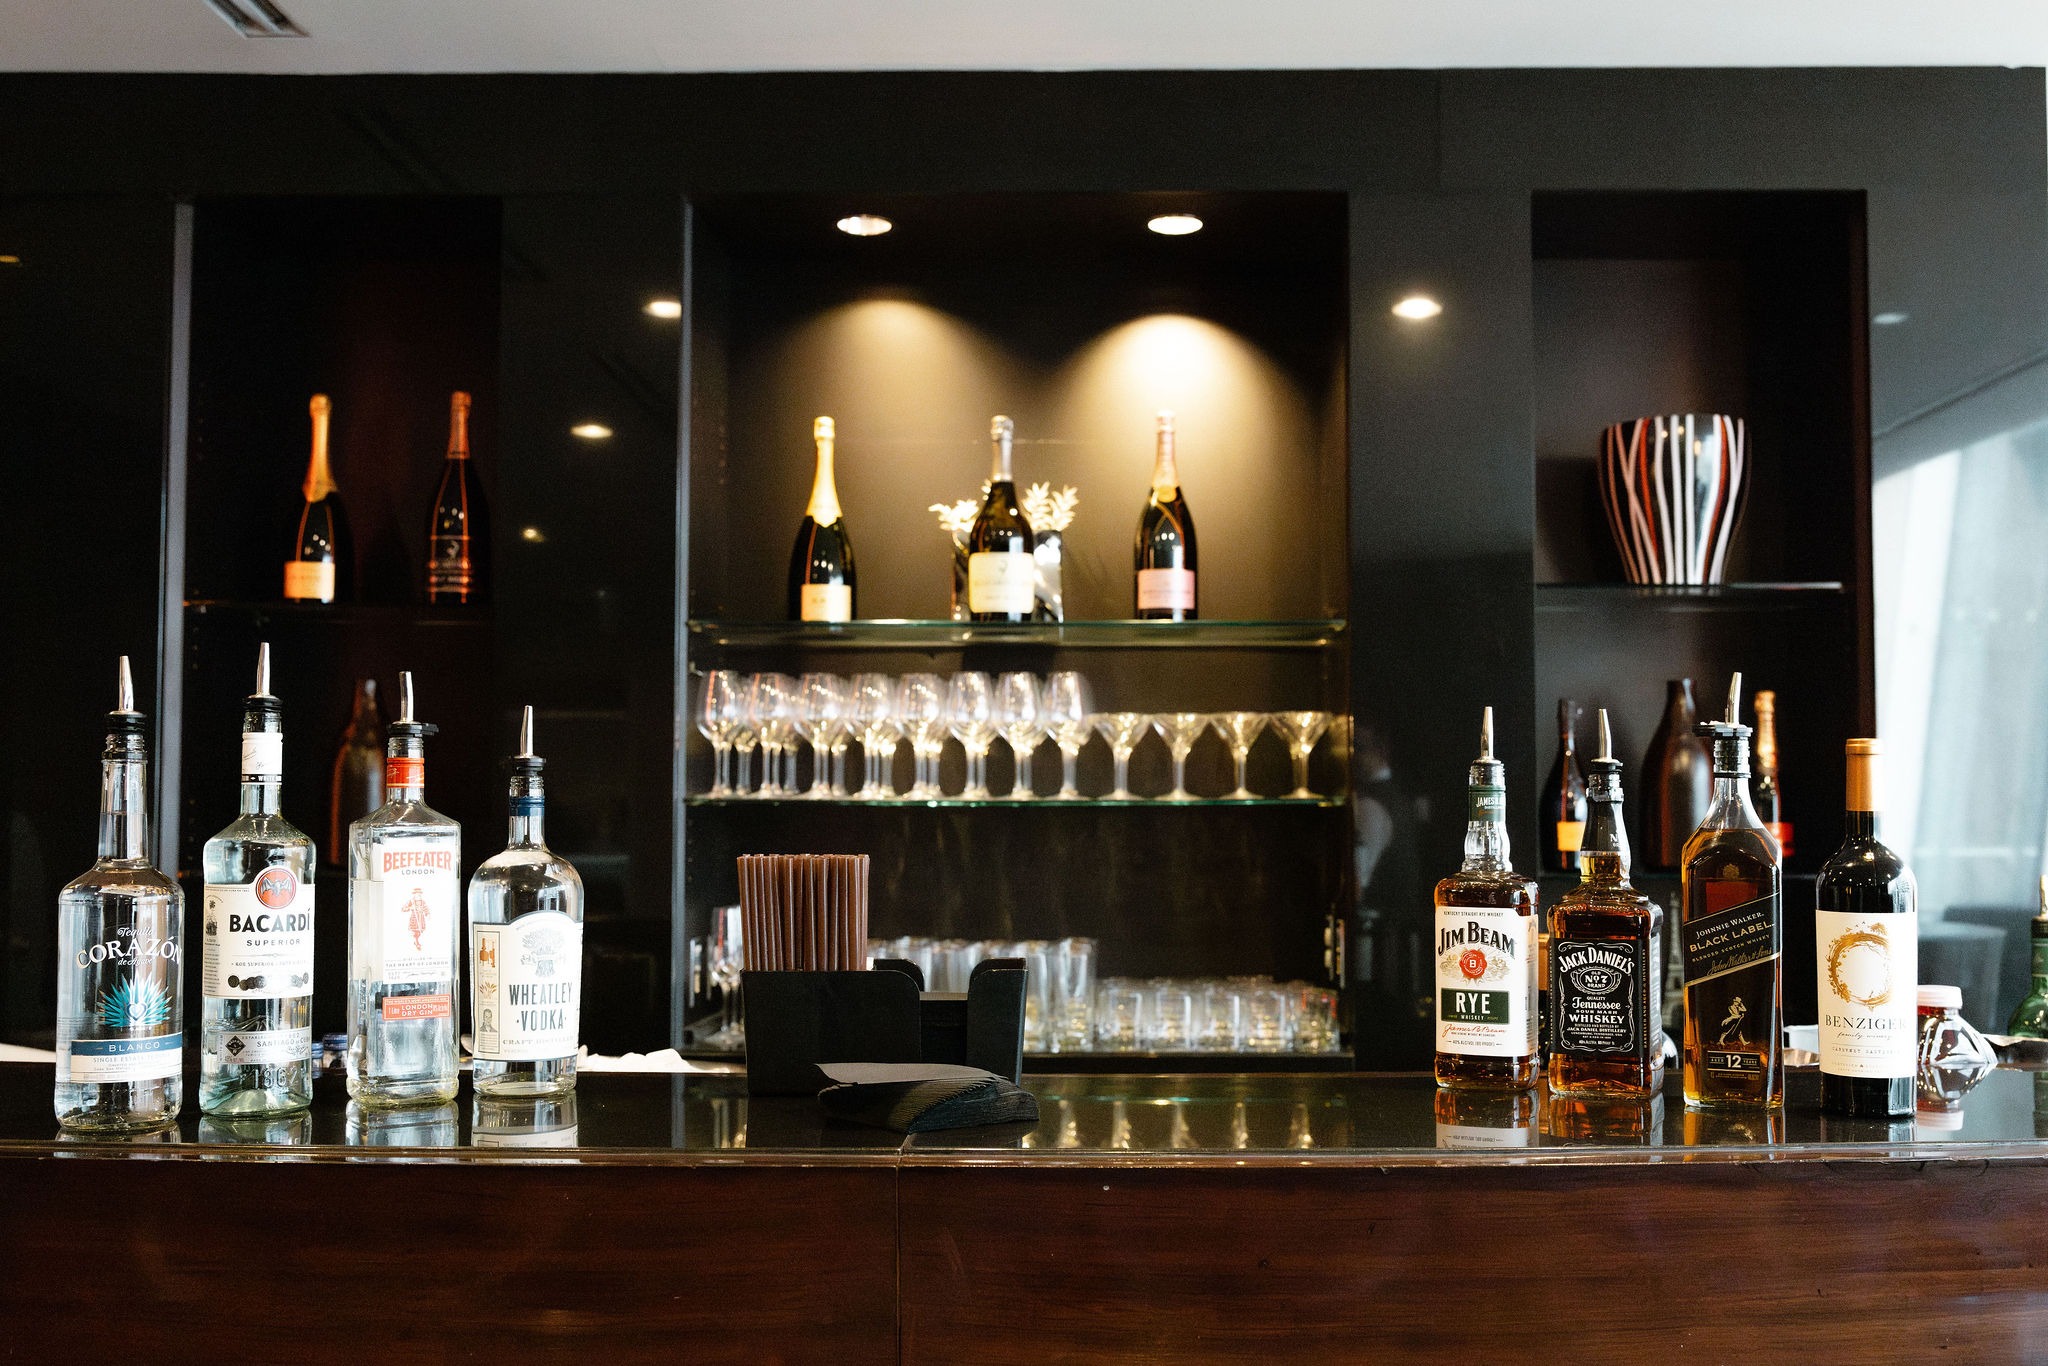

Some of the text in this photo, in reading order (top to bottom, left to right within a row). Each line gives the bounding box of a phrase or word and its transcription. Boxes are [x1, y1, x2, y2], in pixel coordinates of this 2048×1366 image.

[383, 851, 452, 873] BEEFEATER
[116, 927, 153, 938] Tequila
[1696, 911, 1764, 940] JOHNNIE WALKER
[246, 939, 301, 947] SUPERIOR
[1438, 921, 1515, 960] JIM BEAM
[1689, 921, 1772, 953] BLACK LABEL
[1721, 942, 1745, 953] SCOTCH
[76, 935, 182, 969] CORAZÓN
[1558, 946, 1635, 976] JACK DANIEL'S
[509, 982, 573, 1006] WHEATLEY
[1455, 991, 1491, 1014] RYE
[1571, 996, 1621, 1010] Tennessee
[401, 1003, 433, 1011] LONDON
[520, 1008, 564, 1031] VODKA
[1568, 1013, 1625, 1024] WHISKEY
[108, 1041, 160, 1052] BLANCO
[1725, 1054, 1742, 1068] 12
